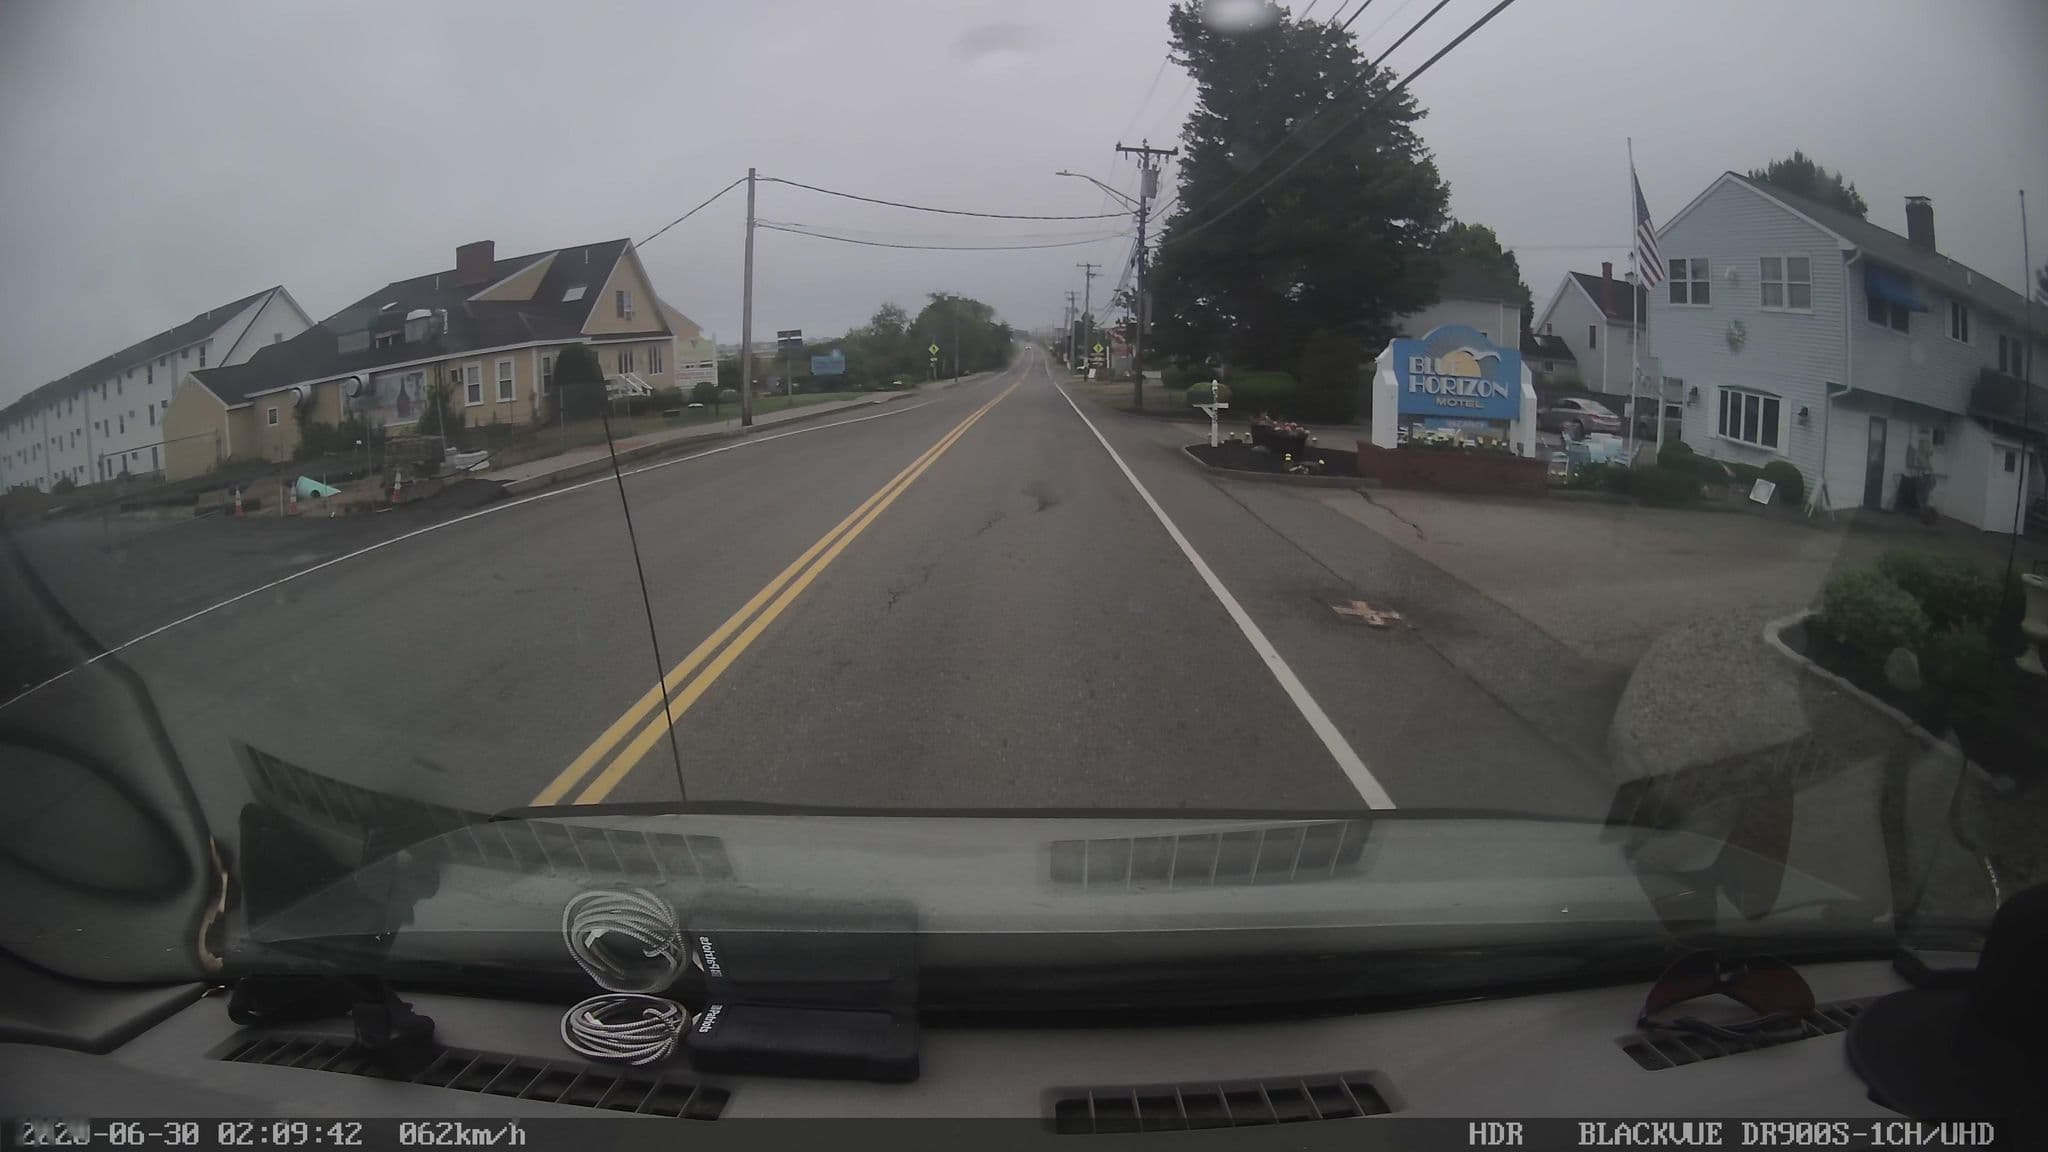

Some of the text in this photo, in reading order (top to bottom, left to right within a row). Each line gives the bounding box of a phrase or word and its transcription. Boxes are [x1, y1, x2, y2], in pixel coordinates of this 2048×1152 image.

[1408, 375, 1509, 400] HORIZON
[1435, 397, 1485, 409] MOTEL
[699, 1008, 721, 1033] Patriots
